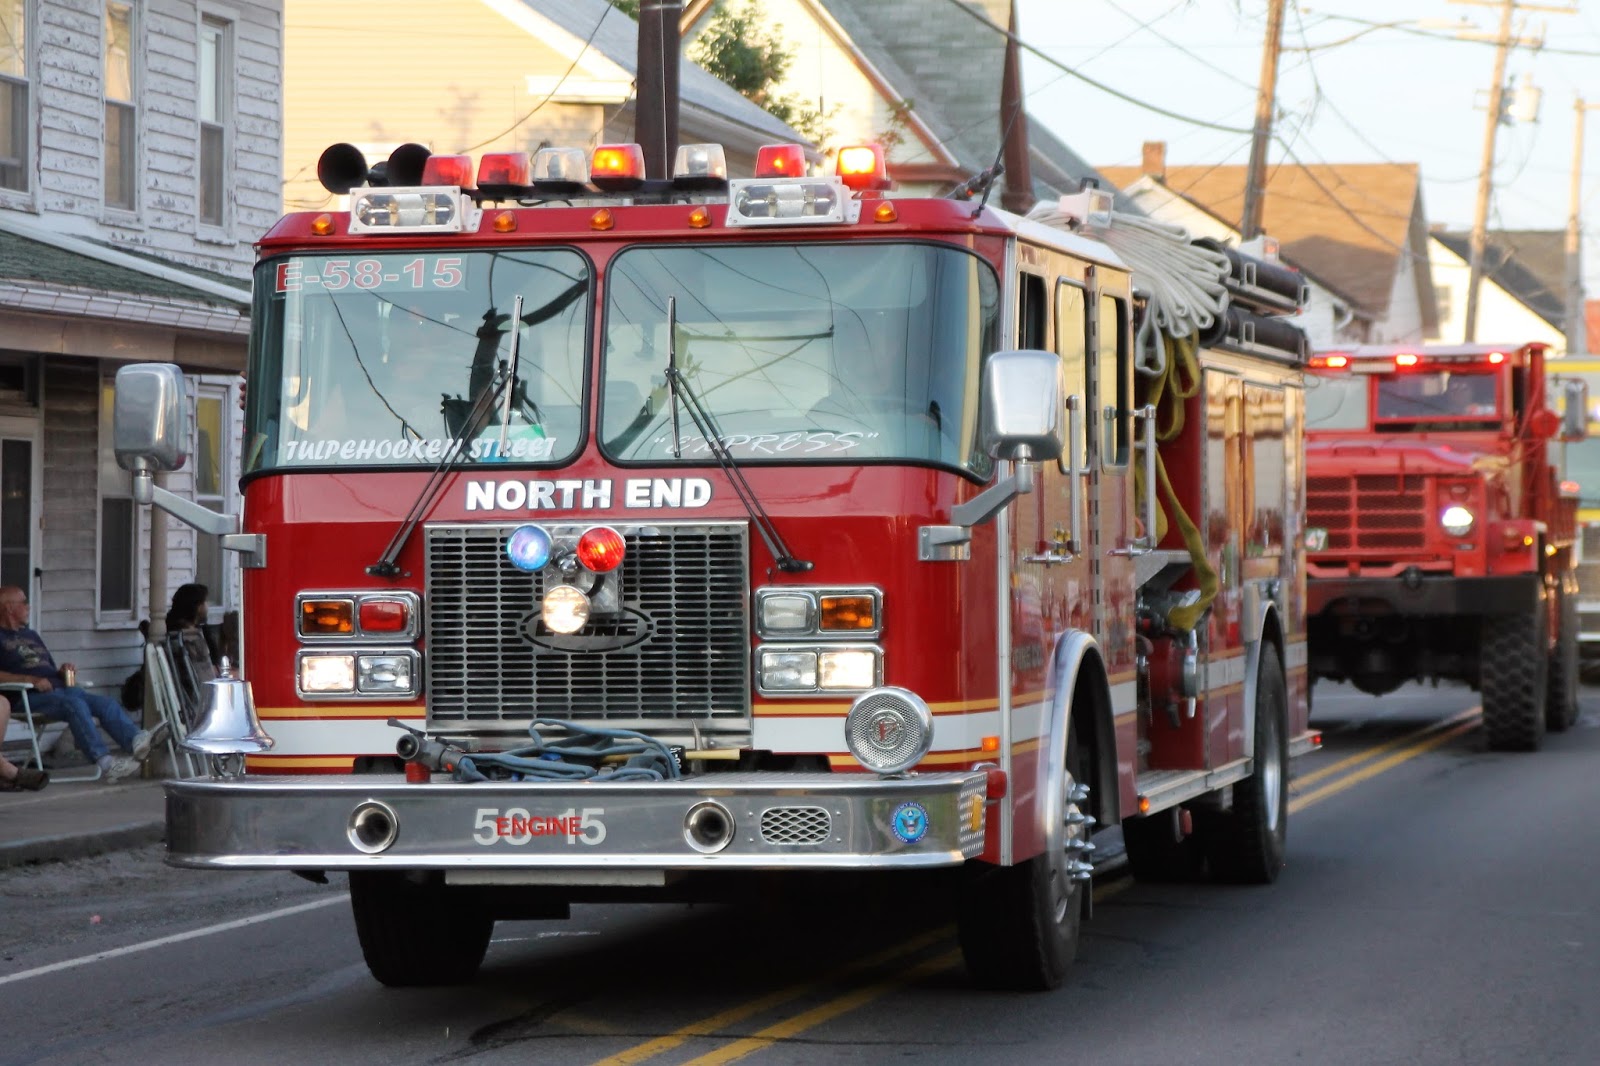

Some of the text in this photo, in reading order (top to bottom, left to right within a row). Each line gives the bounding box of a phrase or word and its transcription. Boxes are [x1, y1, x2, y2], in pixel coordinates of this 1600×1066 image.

[275, 258, 462, 292] E-58-15
[287, 437, 557, 461] TULPEHOCKEN STREET
[466, 478, 712, 511] NORTH END
[496, 816, 584, 837] ENGINE
